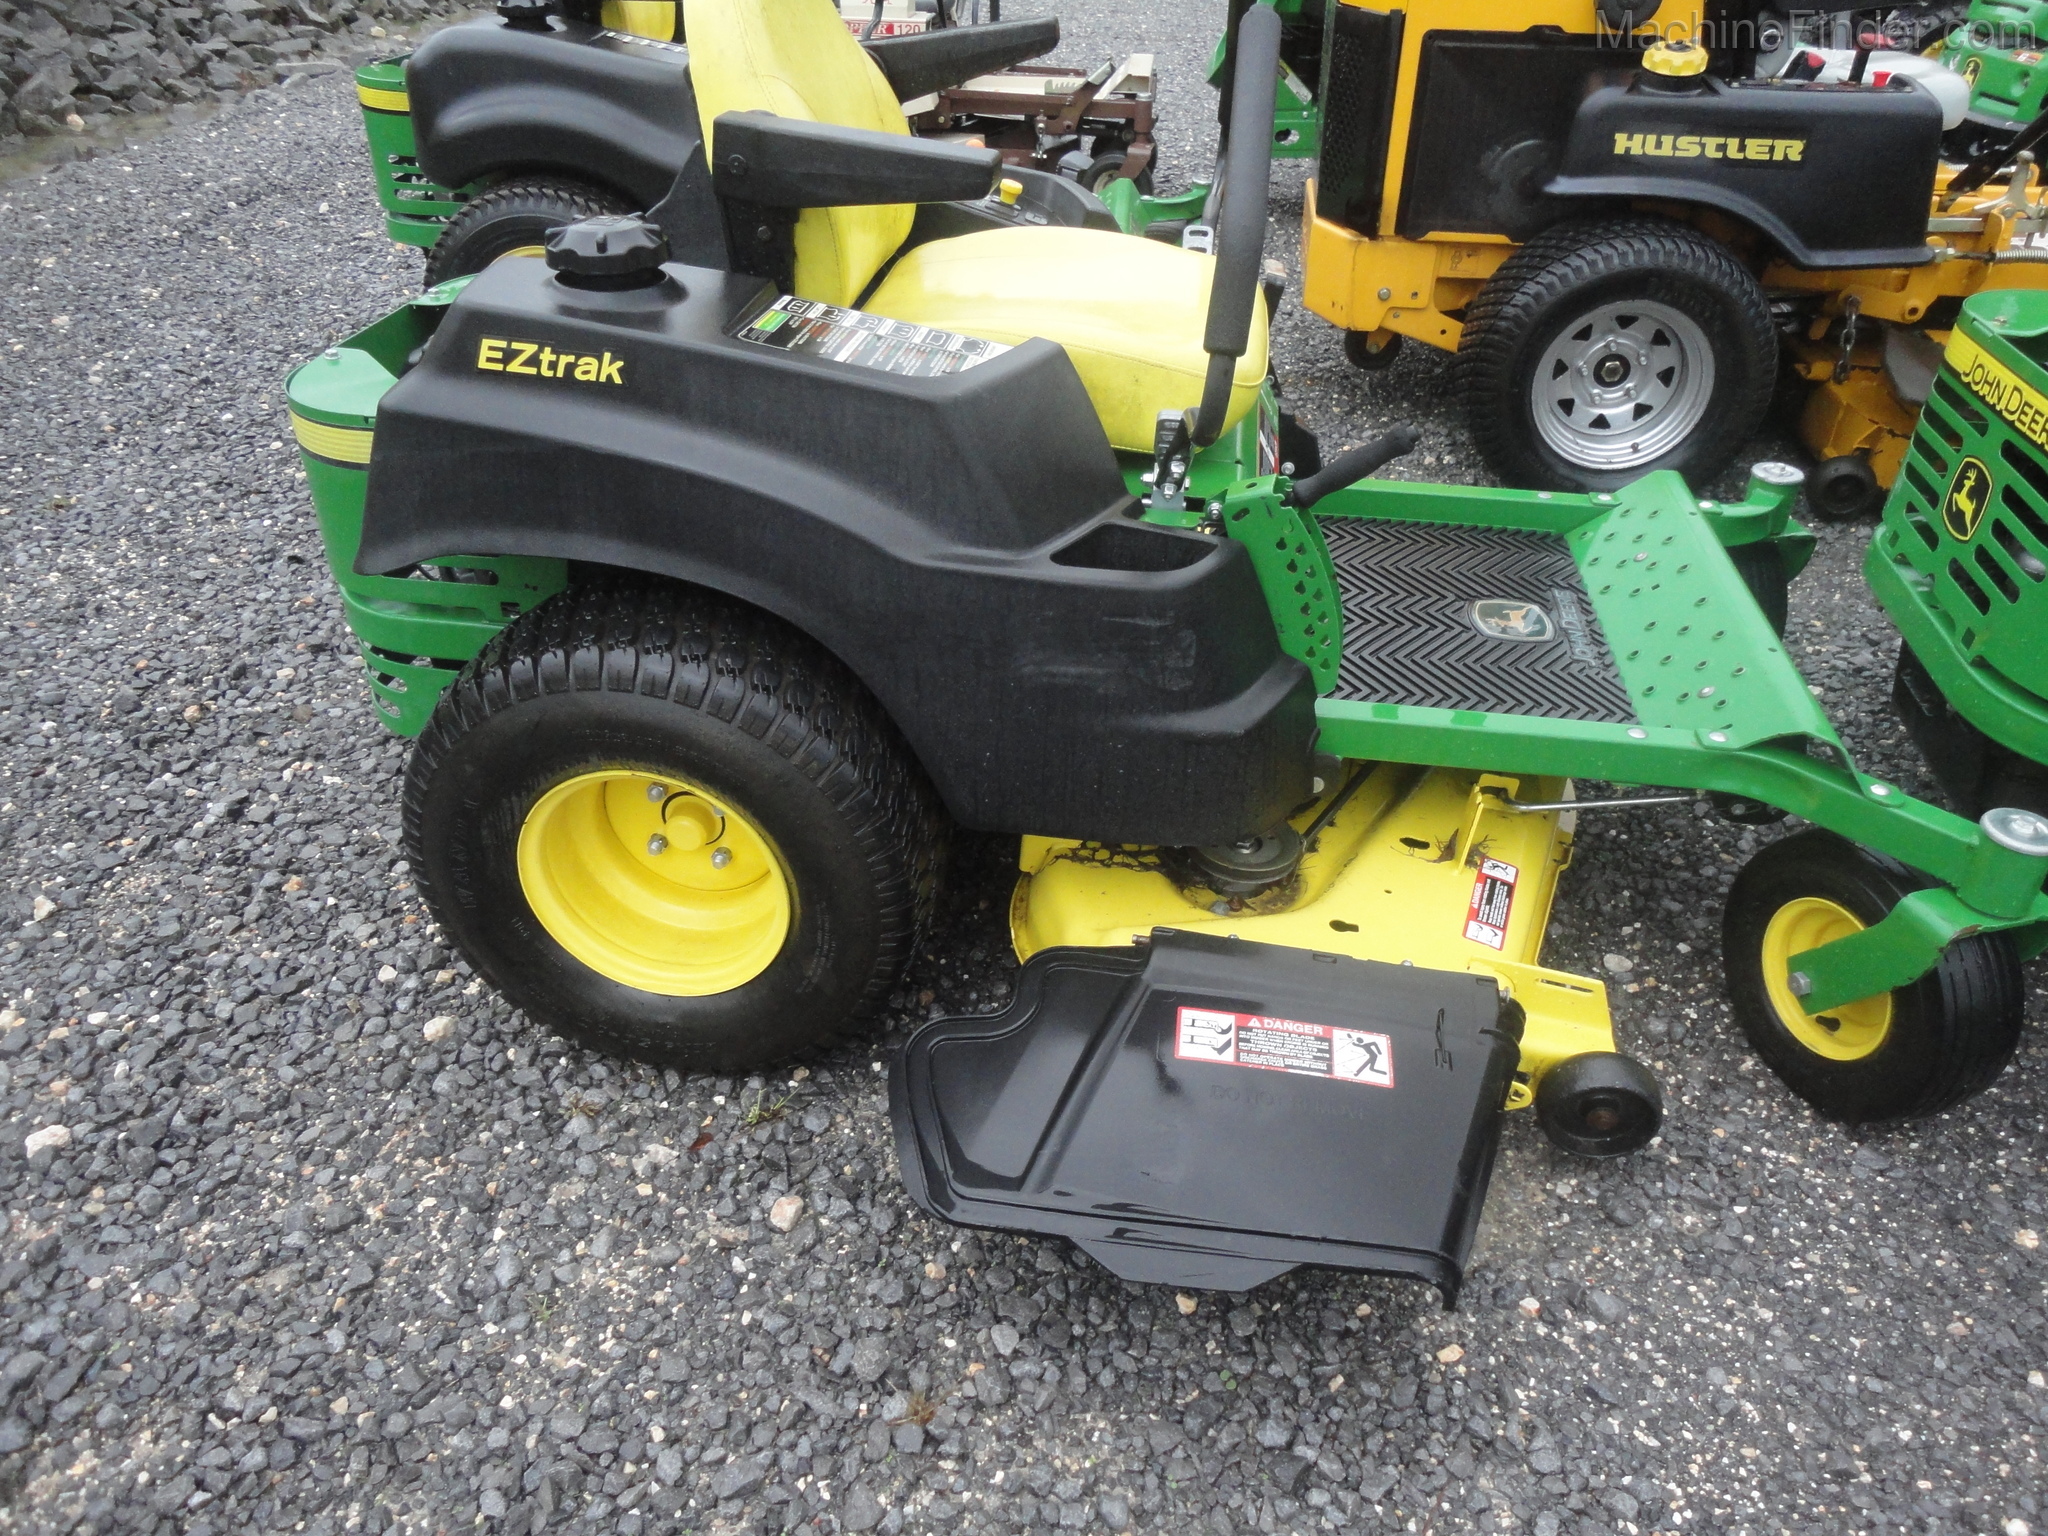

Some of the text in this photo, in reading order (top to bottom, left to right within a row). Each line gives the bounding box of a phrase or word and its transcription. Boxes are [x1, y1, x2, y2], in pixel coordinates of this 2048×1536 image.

[897, 24, 921, 36] 120
[1614, 133, 1804, 161] HUSTLER
[477, 338, 624, 384] EZtrak
[1962, 354, 2008, 406] JOHN
[1568, 630, 1596, 666] JOHN
[1252, 1028, 1289, 1037] ROTATING
[1263, 1019, 1323, 1036] DANGER
[1250, 1039, 1318, 1053] THROWN OBJECTS
